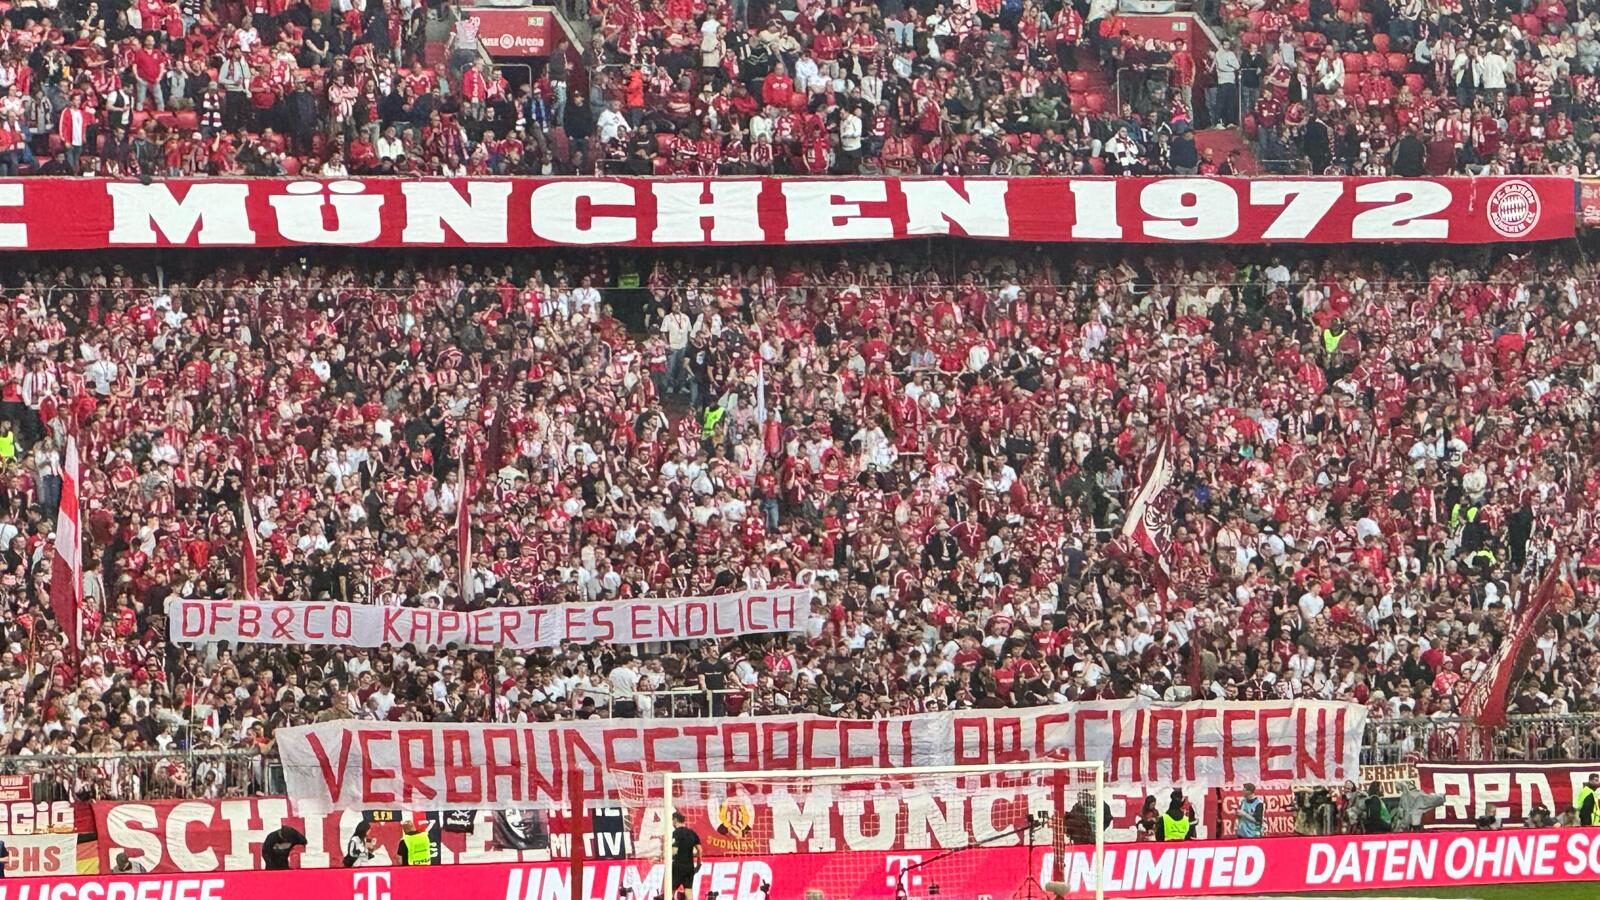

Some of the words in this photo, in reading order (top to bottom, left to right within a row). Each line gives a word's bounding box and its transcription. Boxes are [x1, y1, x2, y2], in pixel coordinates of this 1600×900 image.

[107, 179, 1010, 246] MÜNCHEN
[1070, 178, 1452, 241] 1972
[382, 607, 549, 645] KAPIERT
[565, 607, 614, 641] ES
[631, 595, 795, 640] ENDLICH
[1359, 764, 1418, 781] ERRTE
[1040, 845, 1266, 893] UNLIMITED
[1305, 839, 1438, 885] DATEN
[1444, 834, 1560, 879] OHNE
